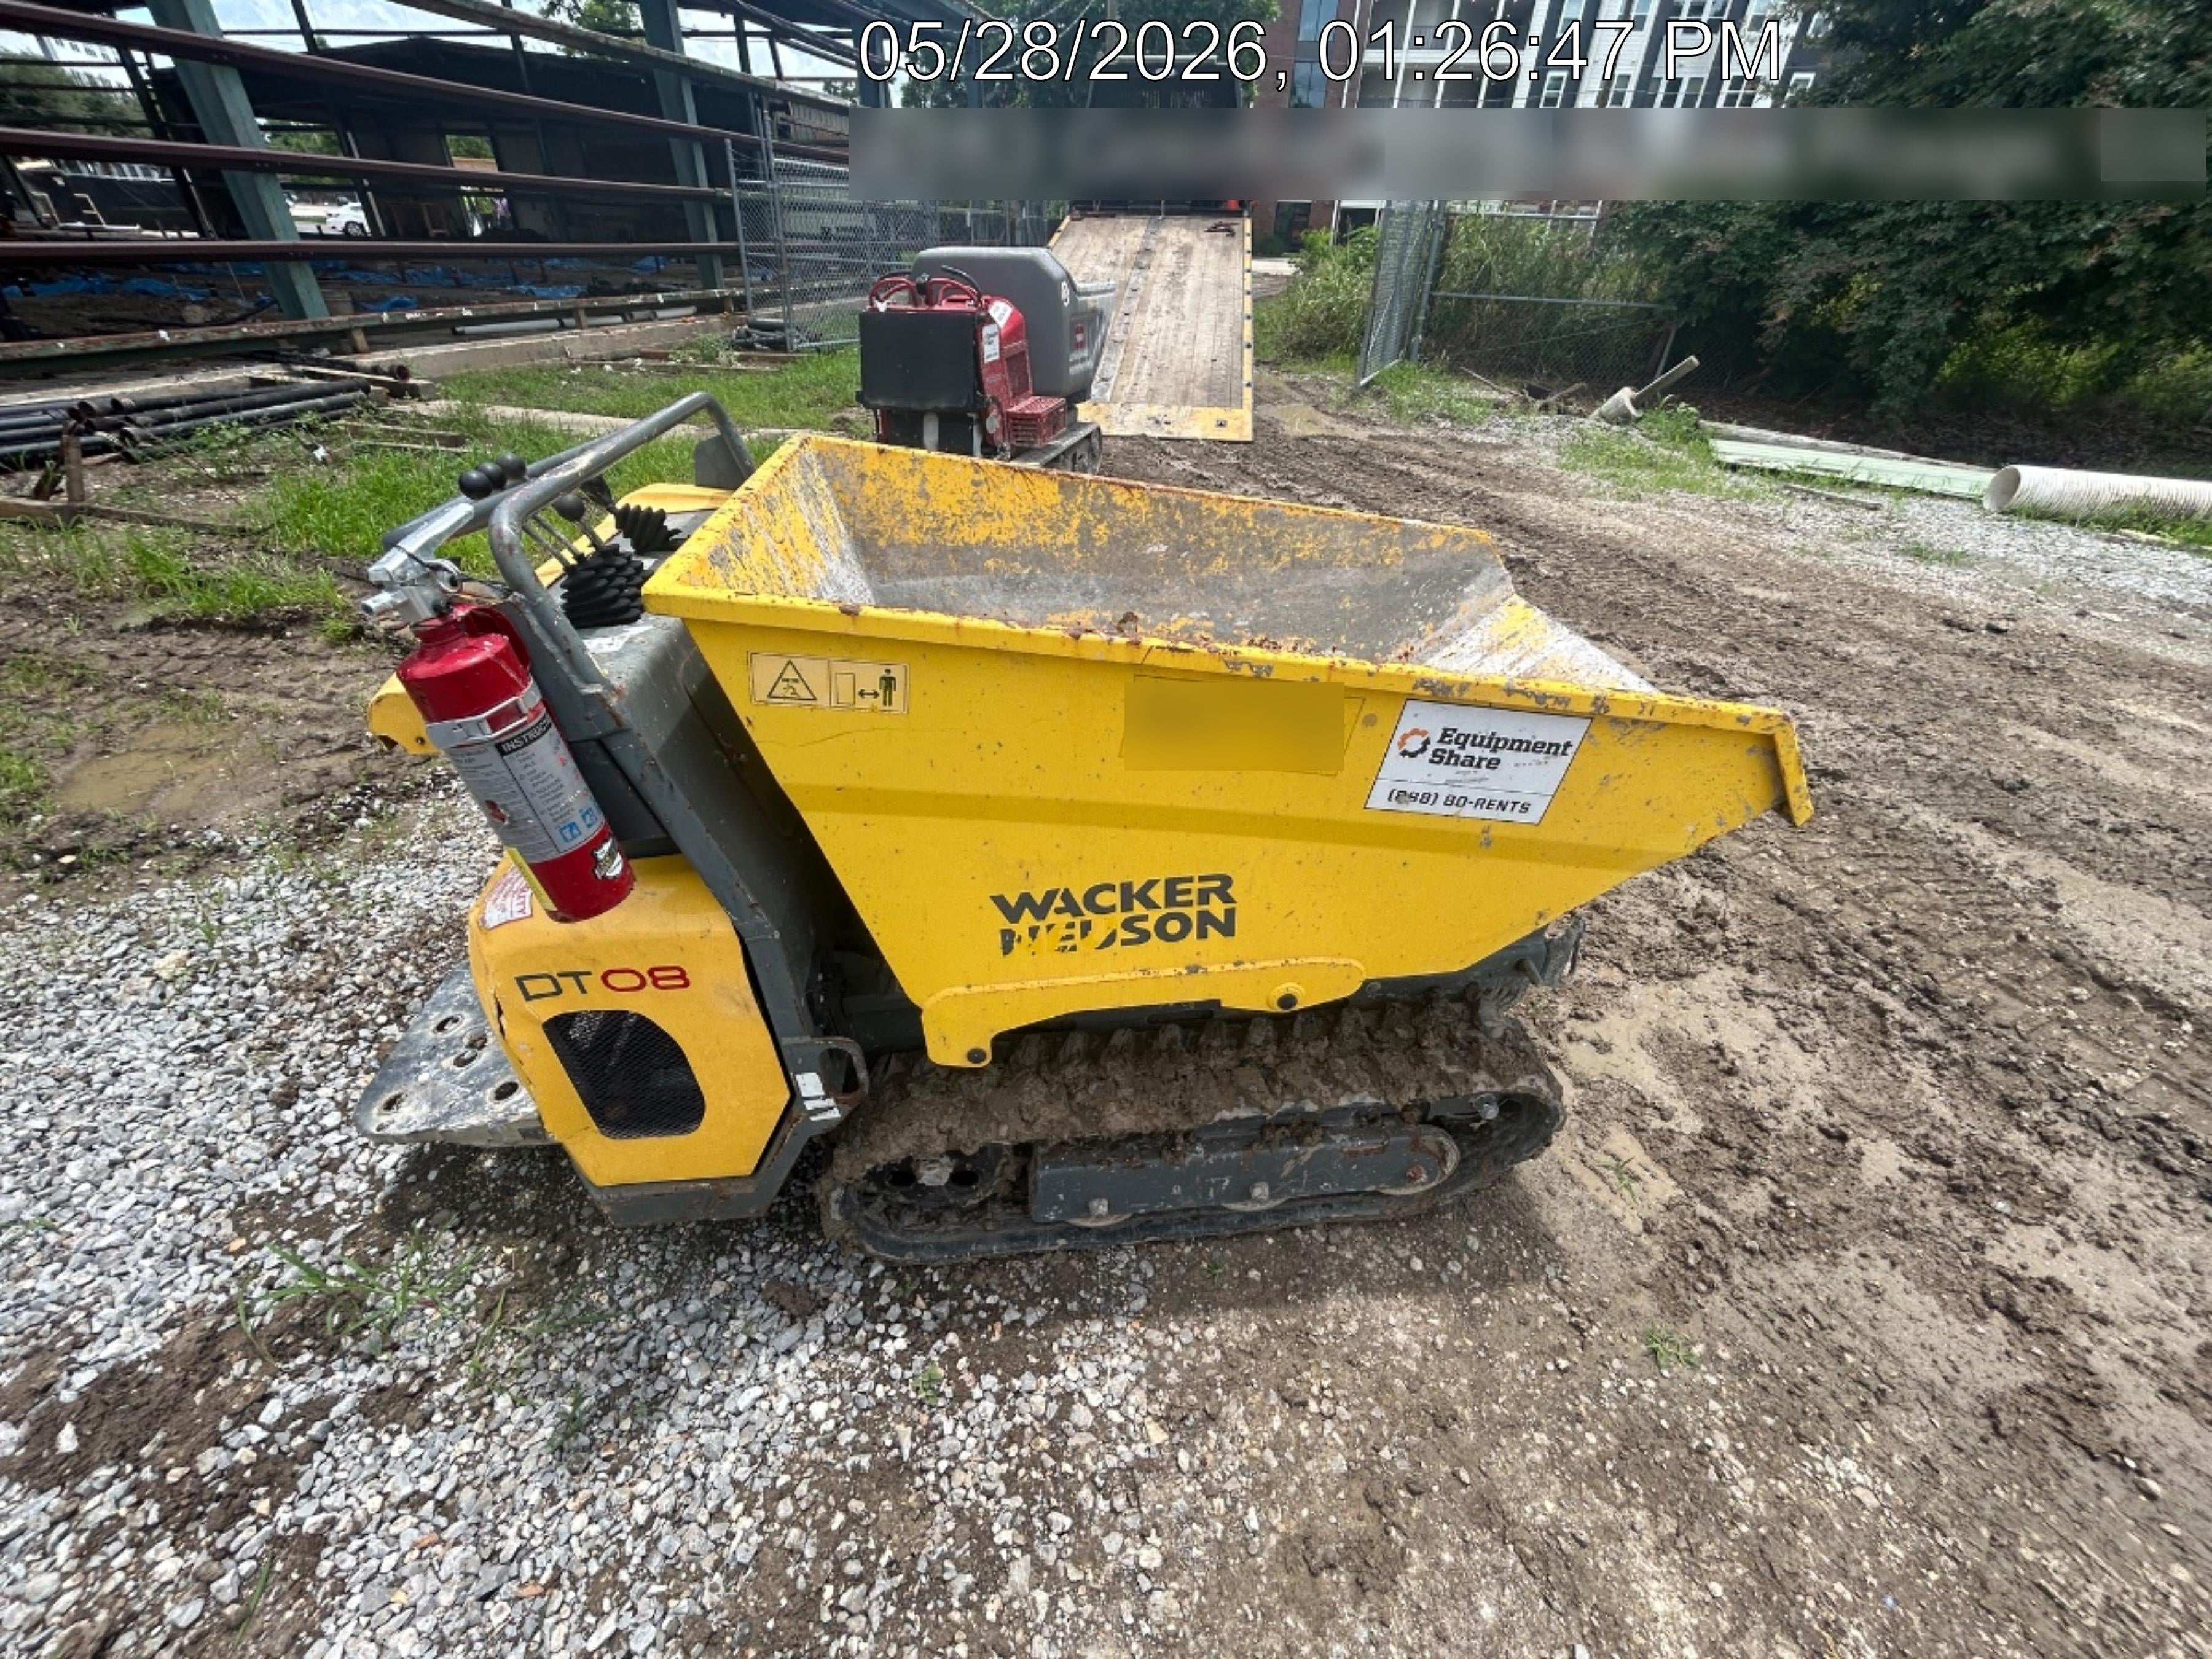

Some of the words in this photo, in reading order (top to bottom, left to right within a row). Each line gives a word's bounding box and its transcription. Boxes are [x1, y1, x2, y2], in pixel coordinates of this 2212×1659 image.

[1436, 727, 1573, 757] Equipment
[1429, 747, 1501, 771] Share
[1443, 794, 1531, 814] 80-RENTS
[989, 873, 1237, 924] WACKER
